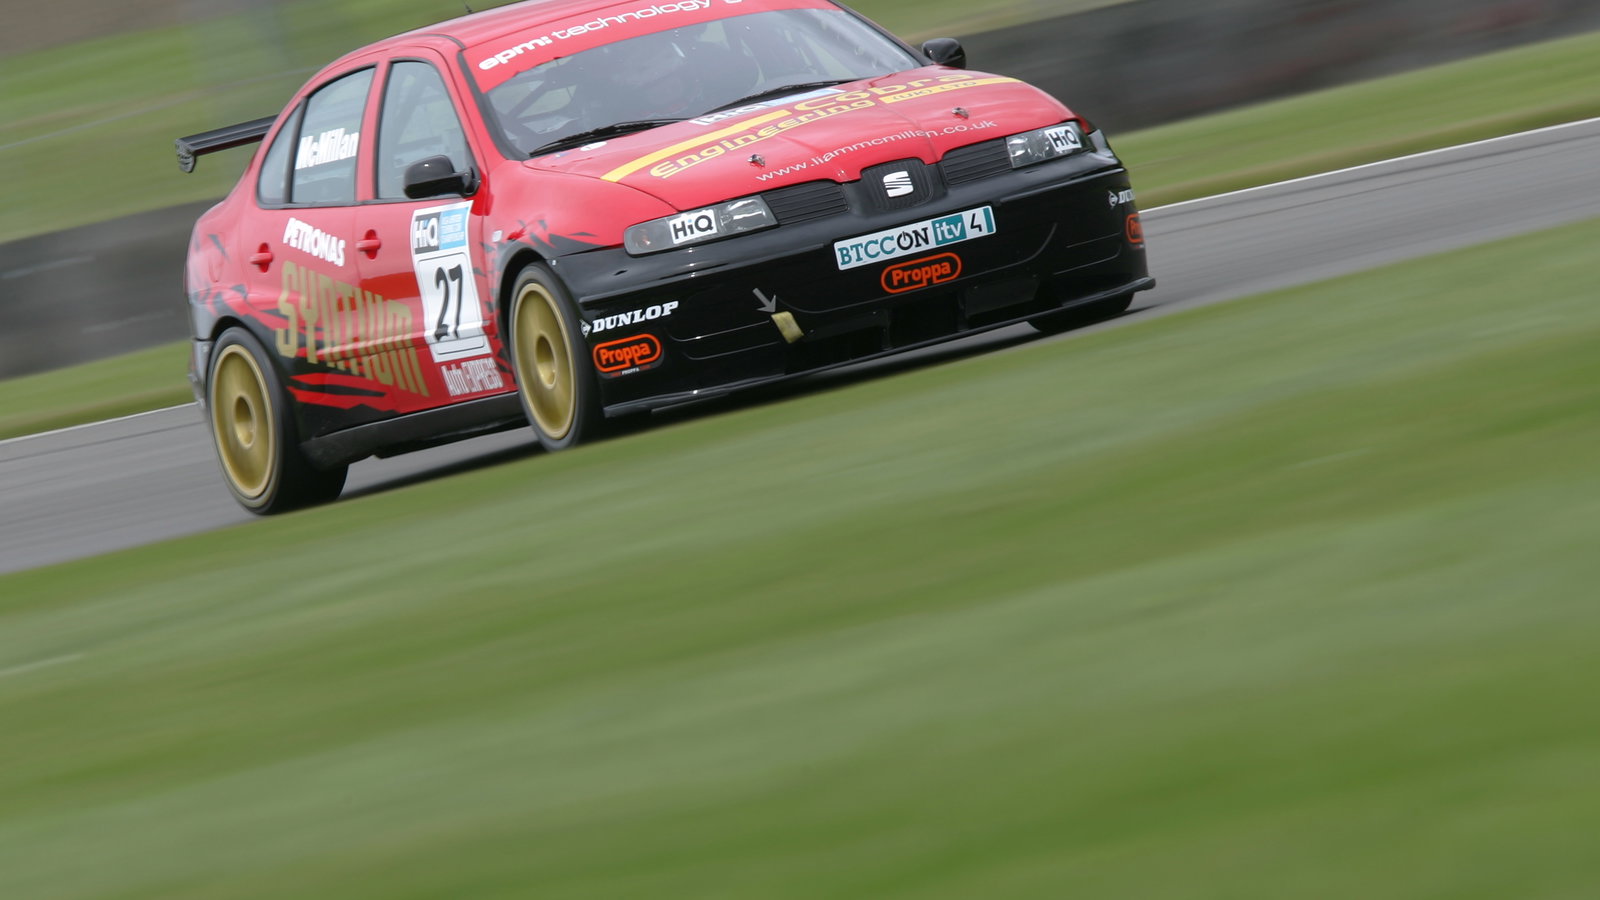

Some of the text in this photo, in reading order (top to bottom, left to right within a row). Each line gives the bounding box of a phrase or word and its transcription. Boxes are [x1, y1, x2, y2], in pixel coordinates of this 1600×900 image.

[552, 0, 711, 39] technology
[794, 74, 976, 111] Cobra
[939, 81, 977, 91] LTD
[295, 128, 359, 170] McMillan
[650, 99, 877, 178] Engineering
[756, 120, 997, 182] www.liammcmillan.co.uk
[1048, 128, 1078, 148] HiQ
[283, 217, 346, 267] PETRONAS
[414, 217, 439, 249] HiQ
[672, 215, 714, 239] HiQ
[935, 221, 962, 241] itv
[970, 213, 982, 232] 4
[891, 260, 952, 287] Proppa
[434, 264, 463, 342] 27
[592, 301, 679, 333] DUNLOP
[600, 343, 652, 366] Proppa
